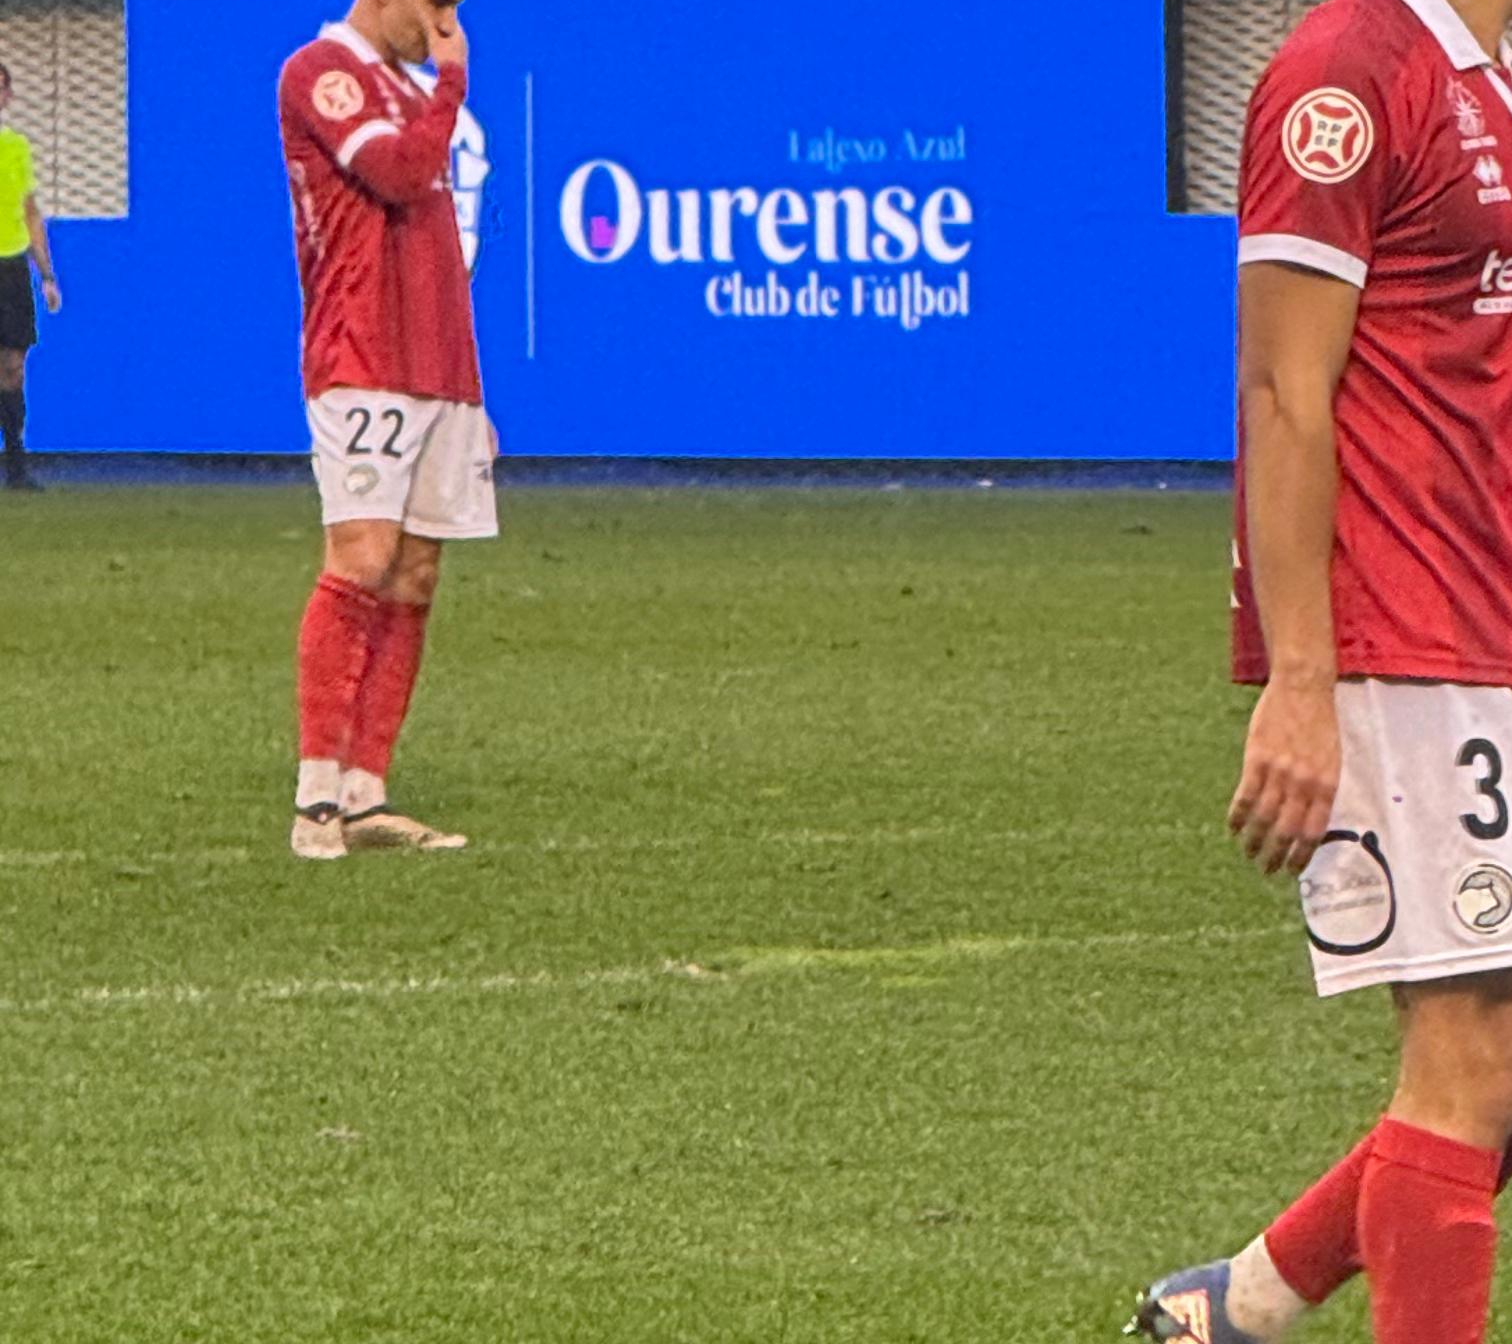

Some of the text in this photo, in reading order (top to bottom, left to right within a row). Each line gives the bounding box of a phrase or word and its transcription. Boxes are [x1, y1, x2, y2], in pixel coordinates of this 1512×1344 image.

[559, 157, 974, 265] Ourense
[704, 269, 791, 318] Club
[795, 269, 841, 318] de
[345, 407, 405, 459] 22
[1455, 737, 1509, 841] 3
